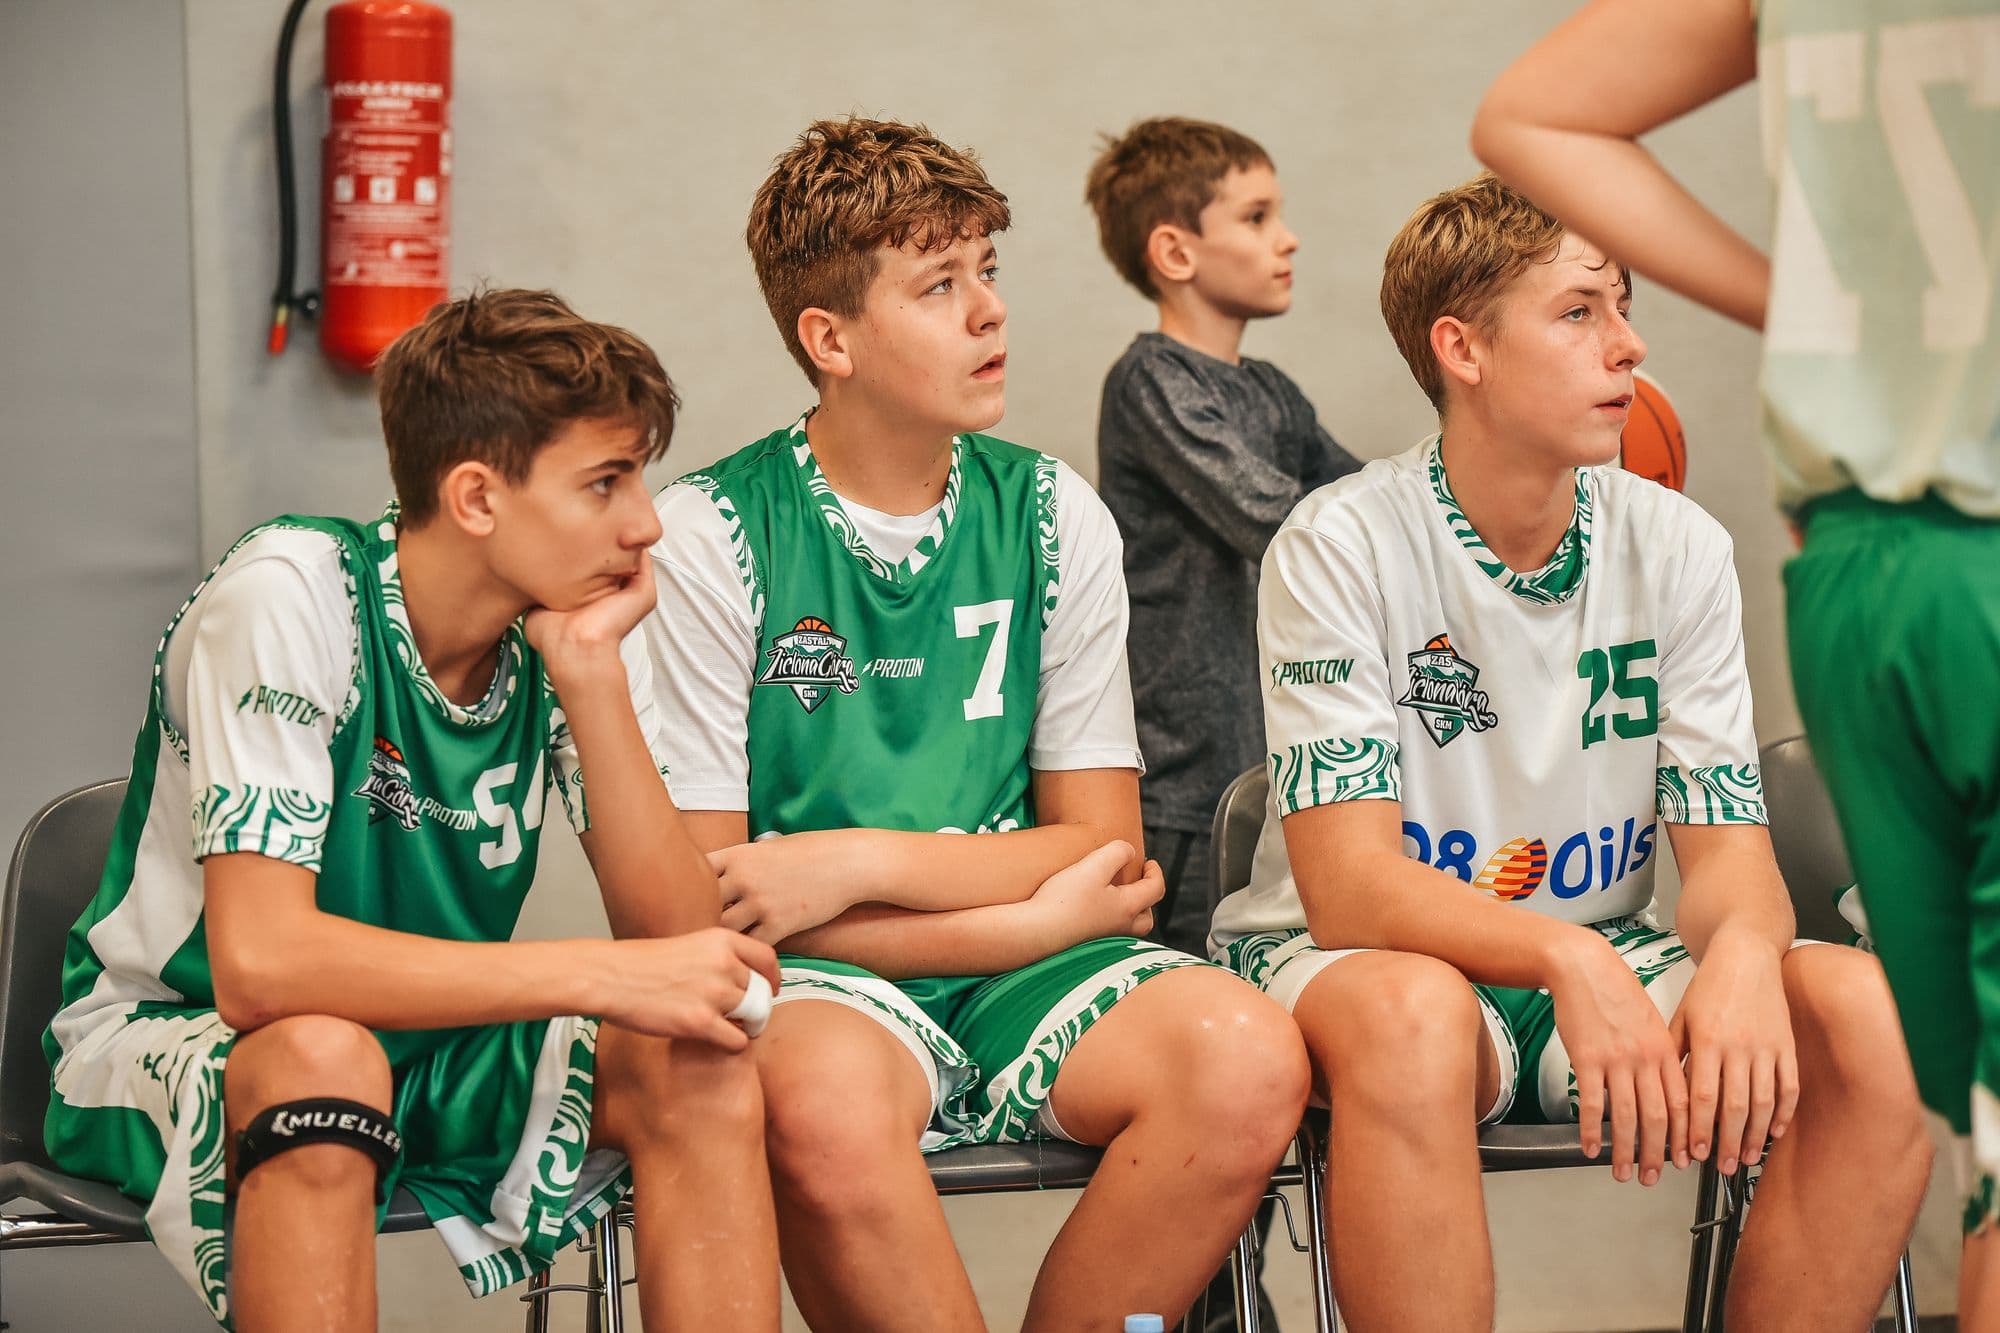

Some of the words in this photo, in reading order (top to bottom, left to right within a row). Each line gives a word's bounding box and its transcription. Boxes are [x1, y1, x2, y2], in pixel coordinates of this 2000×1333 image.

[797, 635, 831, 646] ZASTAL
[871, 657, 925, 679] PROTON
[953, 599, 1015, 721] 7
[1279, 658, 1355, 687] PROTON
[1431, 654, 1453, 667] ZAS
[803, 689, 818, 699] SKM
[1577, 638, 1659, 750] 25
[1434, 718, 1453, 731] SKM
[418, 797, 477, 831] PROTON
[1550, 816, 1657, 899] Oils
